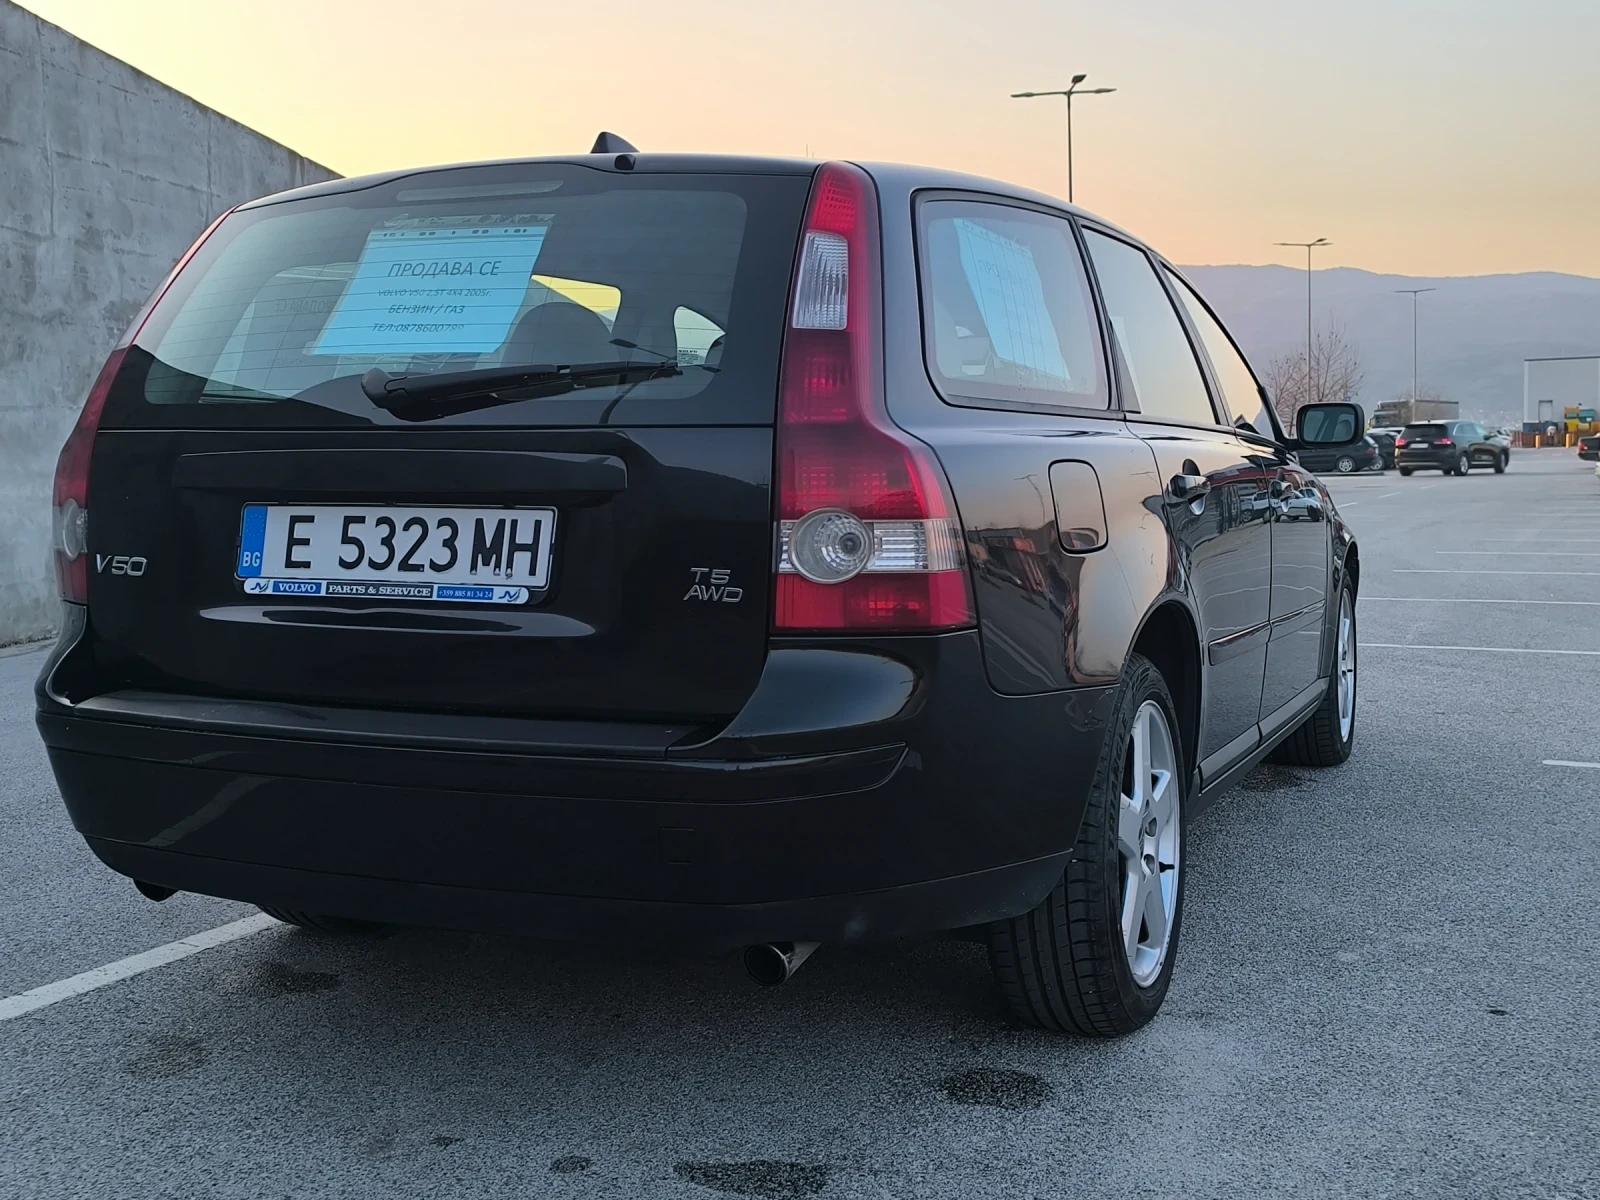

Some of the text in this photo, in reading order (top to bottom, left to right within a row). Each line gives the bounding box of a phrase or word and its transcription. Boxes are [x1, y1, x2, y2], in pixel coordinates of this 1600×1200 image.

[387, 260, 502, 279] ПРОДАВА СЕ
[378, 288, 407, 297] VOLVO
[408, 288, 425, 297] V50
[446, 288, 463, 297] 4X4
[388, 304, 434, 314] БЕНЗИН
[444, 305, 466, 314] ГАЗ
[284, 515, 542, 577] E 5323 MH
[96, 553, 147, 576] V50
[242, 552, 261, 568] BG
[690, 567, 731, 585] T5
[278, 582, 431, 597] VOLVO PARTS & SERVICE
[438, 589, 453, 597] +359
[466, 590, 474, 598] 81
[683, 584, 743, 602] AWD
[1108, 711, 1128, 851] TRIANGLE
